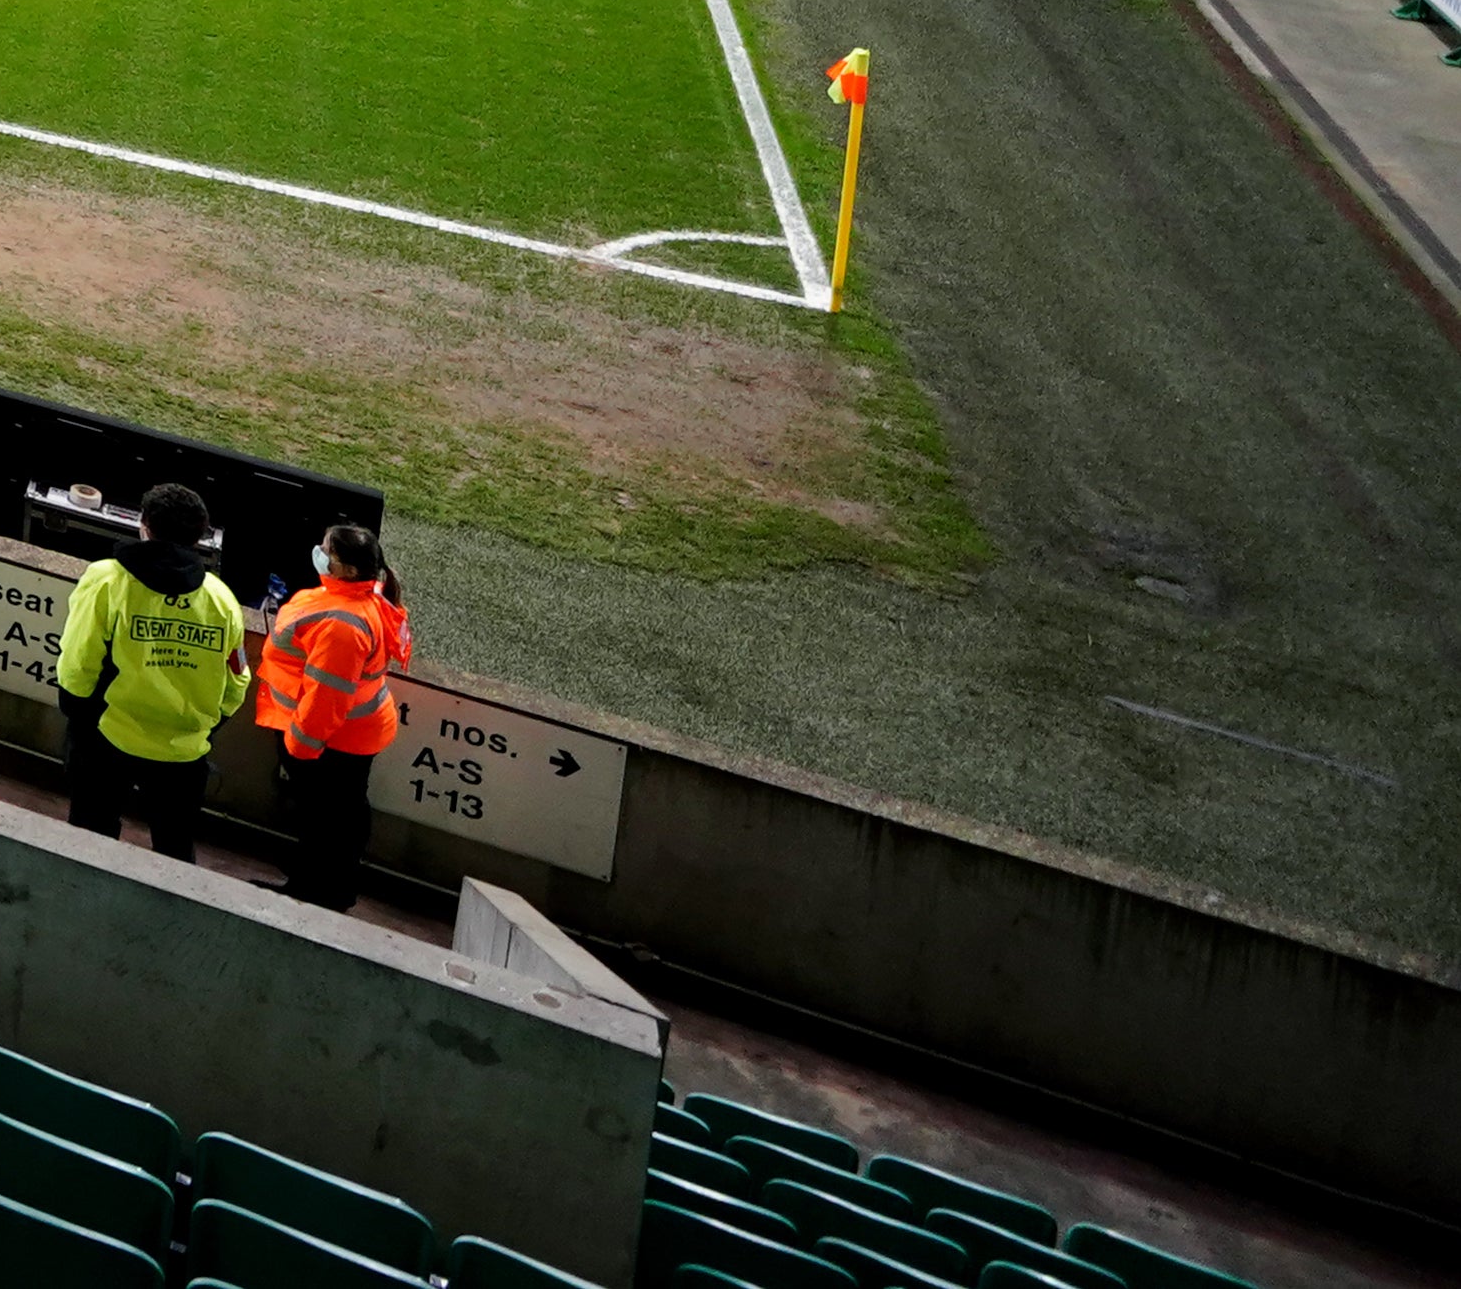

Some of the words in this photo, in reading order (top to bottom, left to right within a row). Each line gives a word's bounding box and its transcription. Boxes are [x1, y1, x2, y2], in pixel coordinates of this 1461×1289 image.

[136, 618, 173, 639] EVENT
[176, 625, 217, 646] STAFF
[145, 658, 173, 669] assist
[175, 662, 198, 671] you
[151, 647, 177, 656] Here
[180, 649, 190, 657] to
[440, 718, 518, 759] nos.
[411, 746, 484, 786] A-S
[409, 779, 485, 820] 1-13
